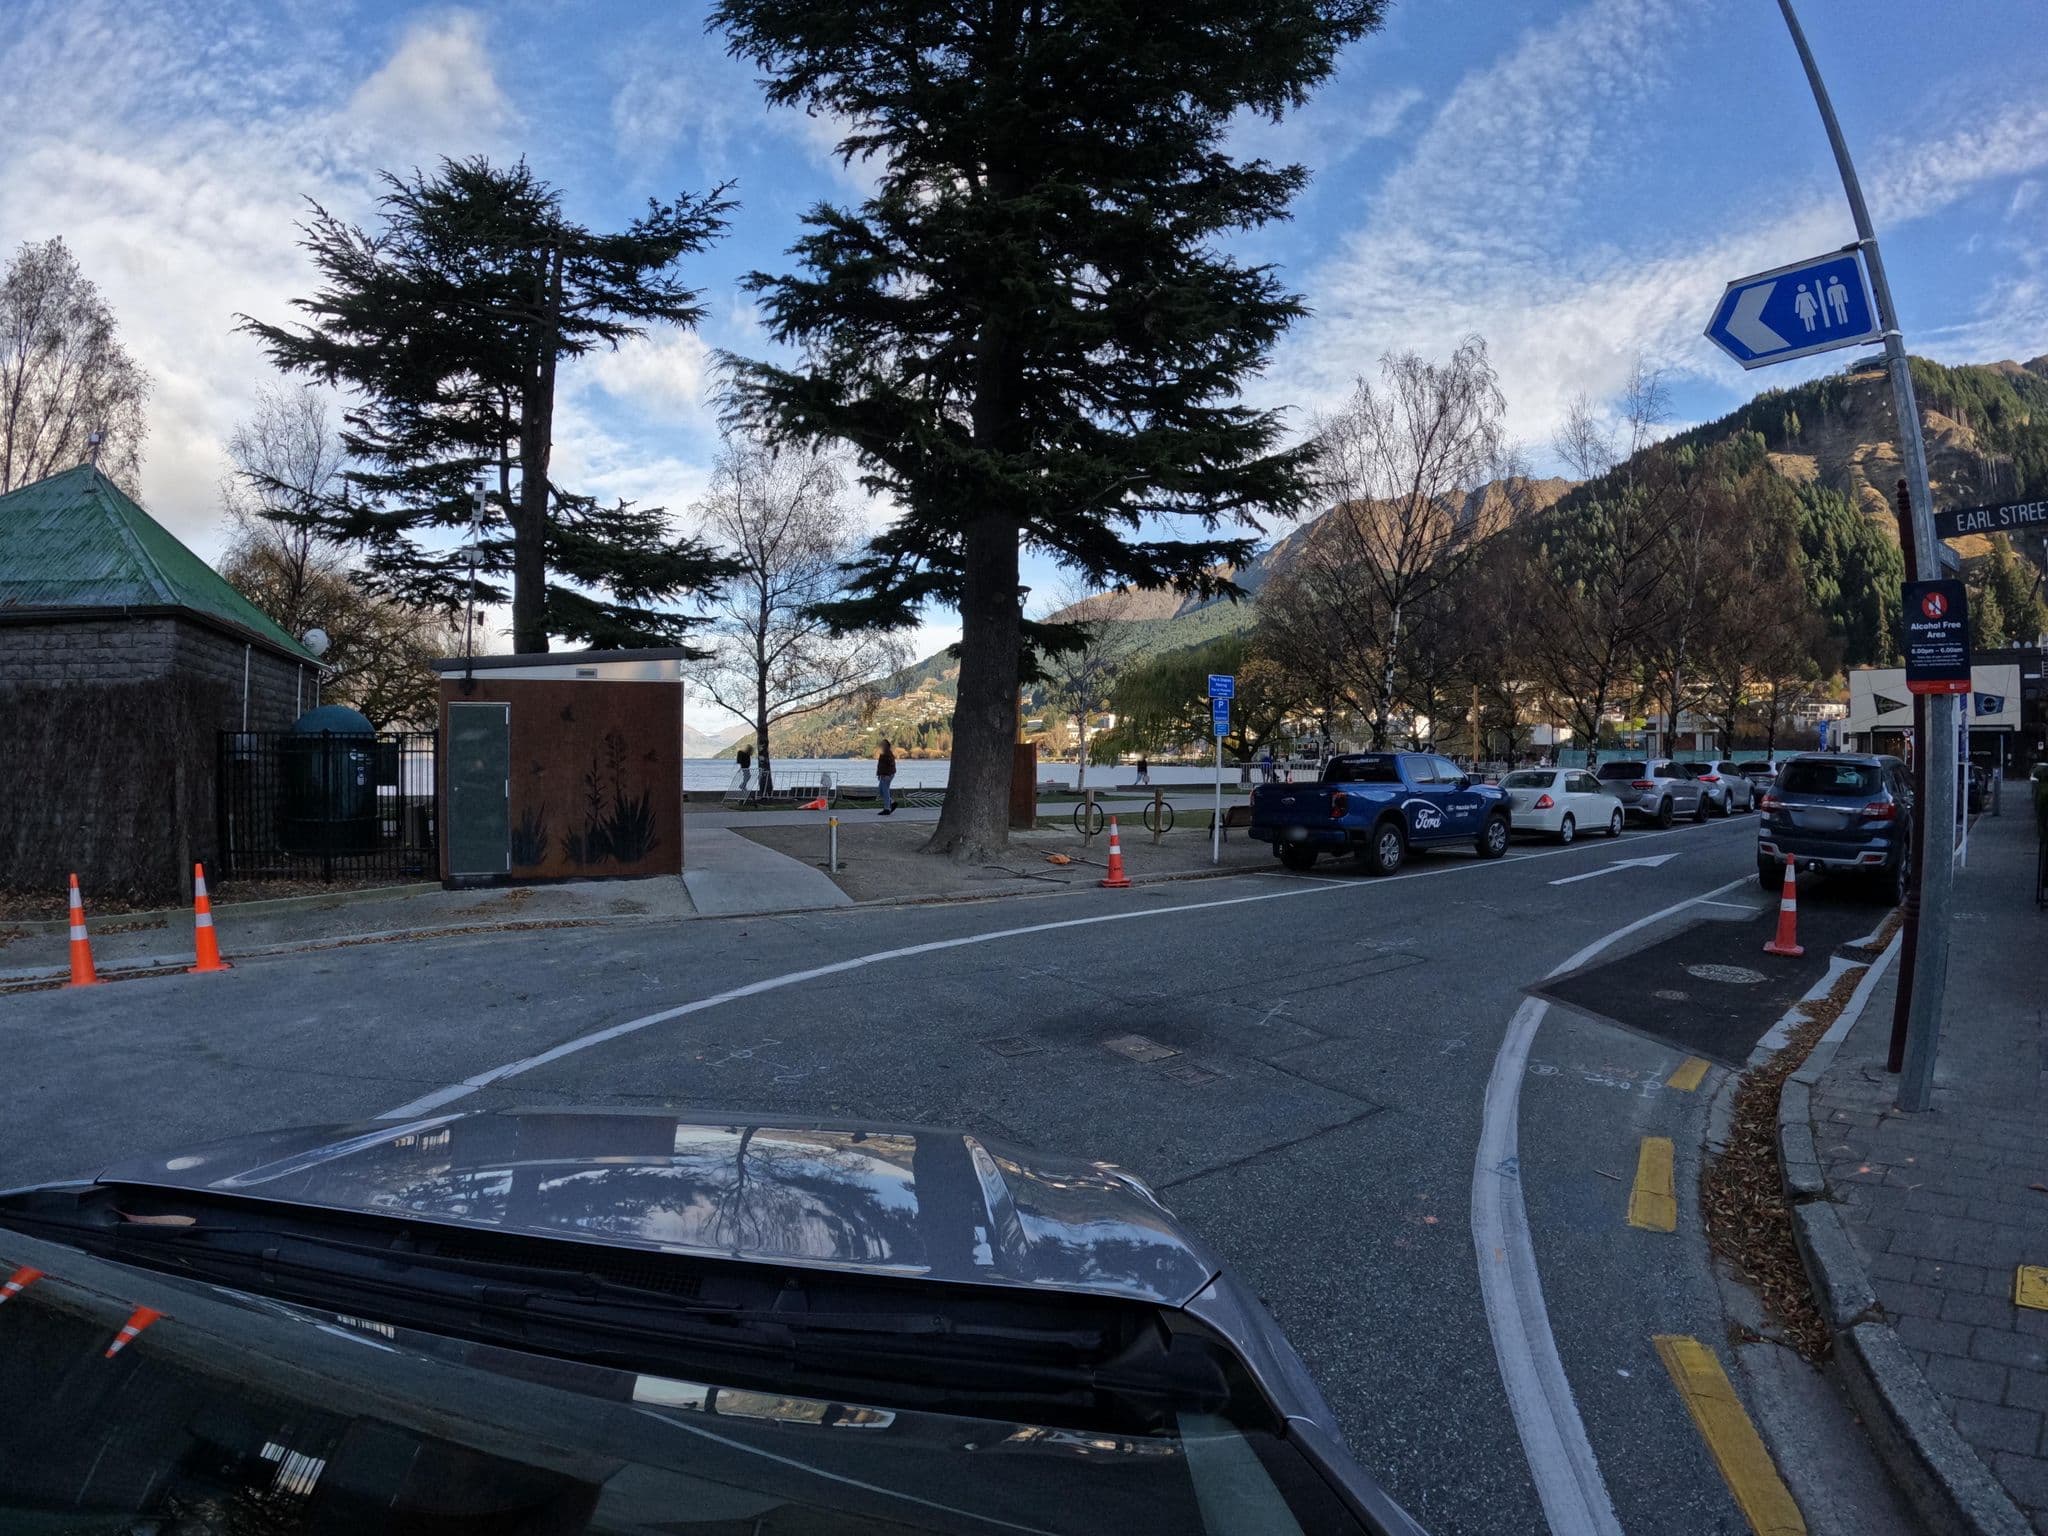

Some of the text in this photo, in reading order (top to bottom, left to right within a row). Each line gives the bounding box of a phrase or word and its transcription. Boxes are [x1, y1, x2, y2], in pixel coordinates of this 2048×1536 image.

[1956, 501, 2048, 531] EARL STREE
[1911, 622, 1941, 630] Alcohol
[1218, 701, 1224, 709] P
[1415, 809, 1441, 829] Ford
